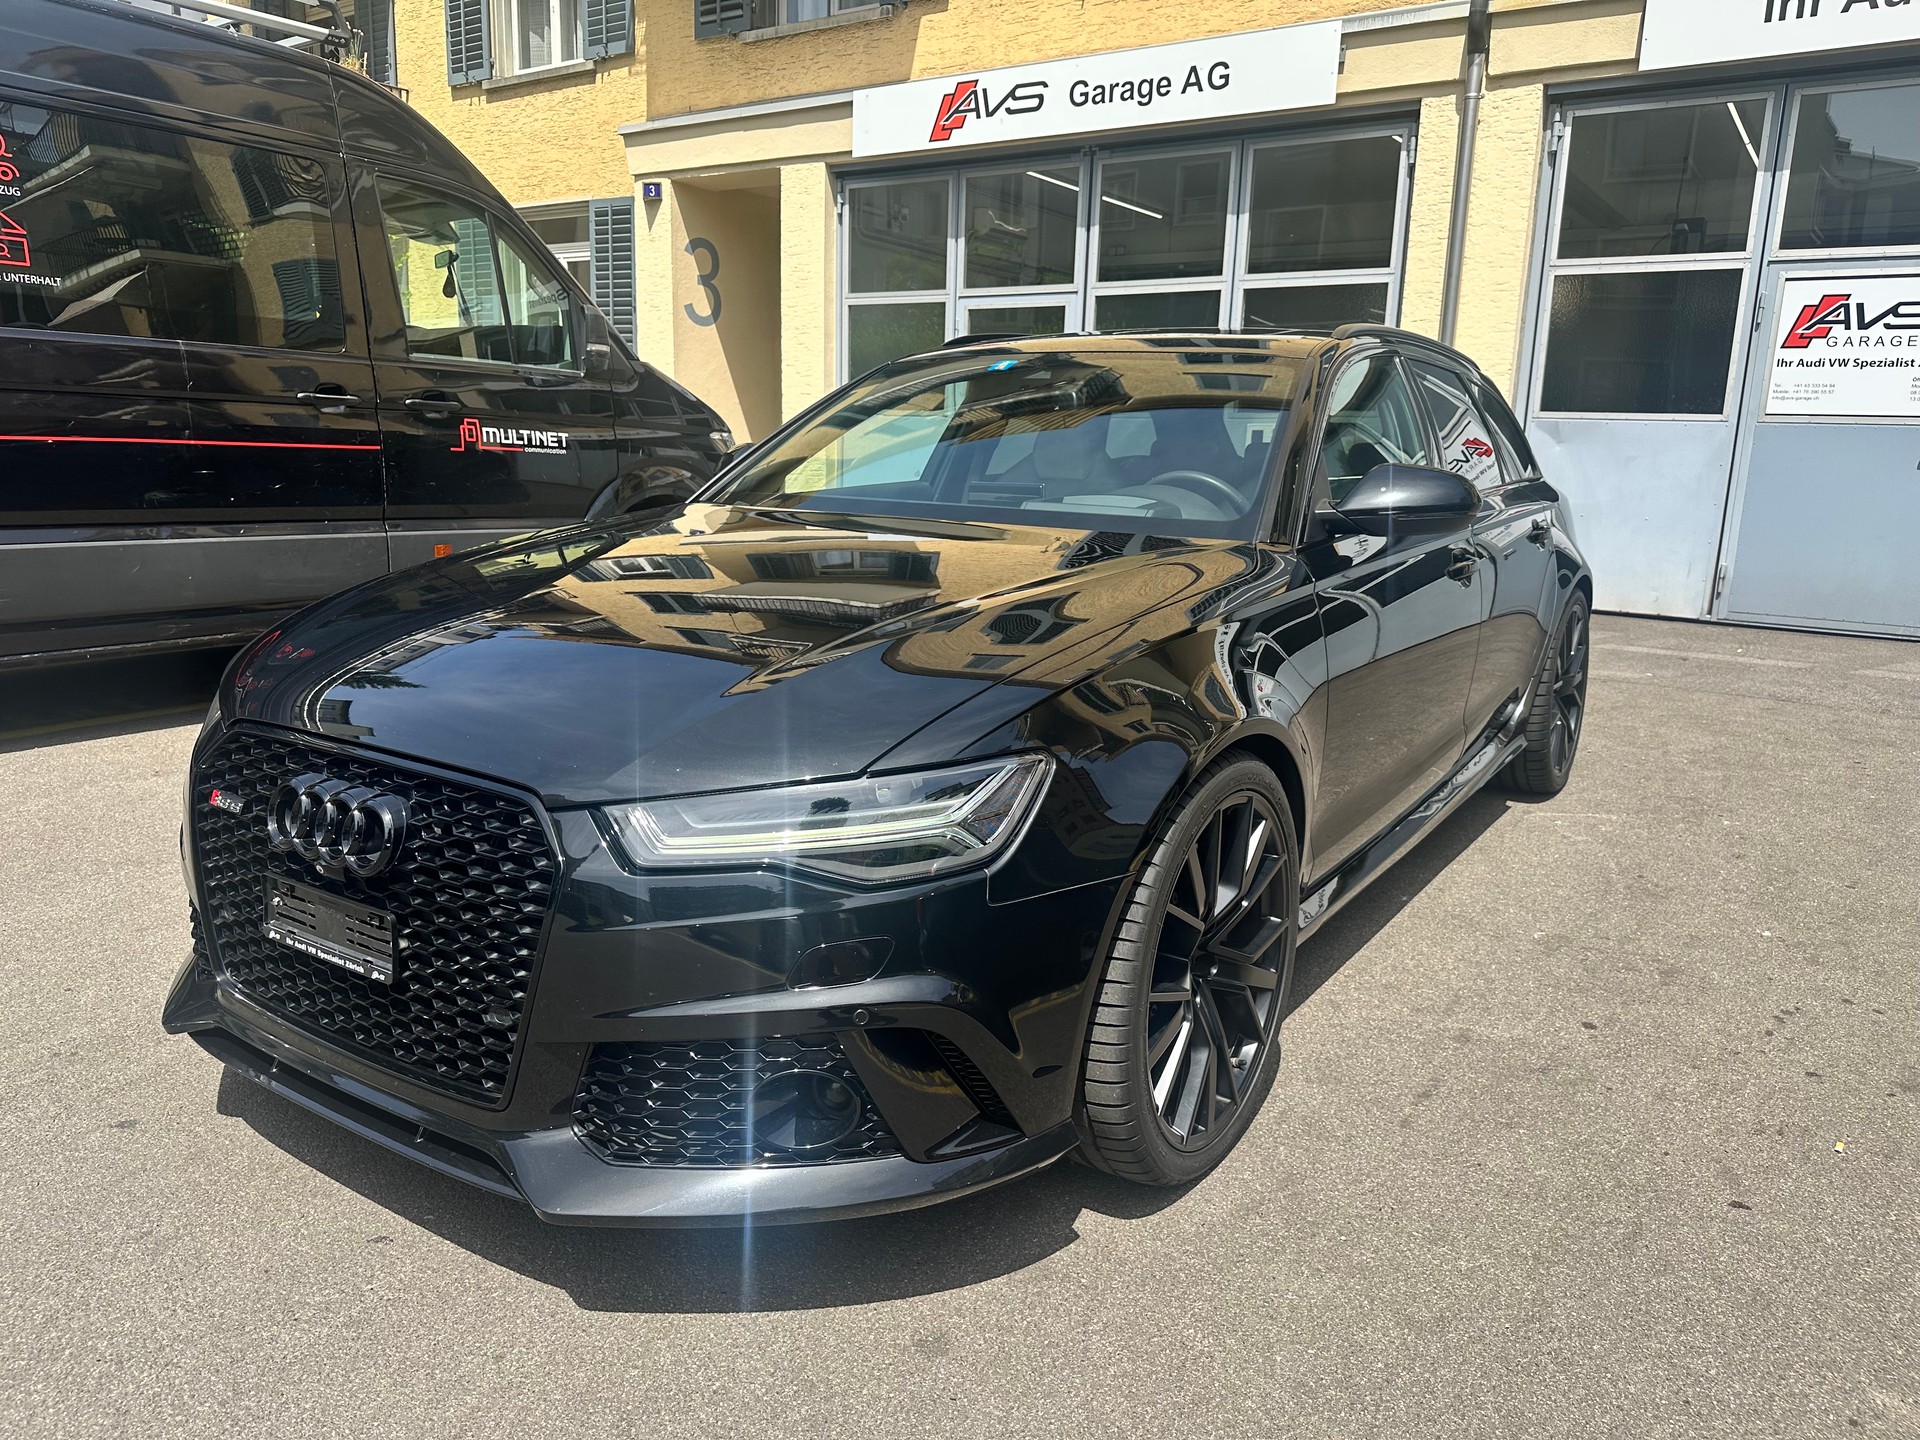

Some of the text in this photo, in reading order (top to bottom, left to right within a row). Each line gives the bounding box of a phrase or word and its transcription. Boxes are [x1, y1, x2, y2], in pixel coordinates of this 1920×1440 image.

[944, 61, 1231, 123] AVS Garage AG
[649, 185, 655, 196] 3
[3, 272, 61, 287] UNTERHALT
[684, 237, 722, 327] 3
[1826, 335, 1918, 348] GARAGE
[1776, 358, 1794, 368] Ihr
[1796, 357, 1826, 368] Audi
[1828, 358, 1851, 368] VW
[1852, 357, 1916, 370] Spezialist
[481, 426, 569, 448] MULTINET
[524, 447, 567, 455] communication
[286, 936, 294, 946] Ihr
[294, 940, 307, 951] Audi
[307, 945, 317, 955] VW
[317, 951, 345, 966] Spezialist
